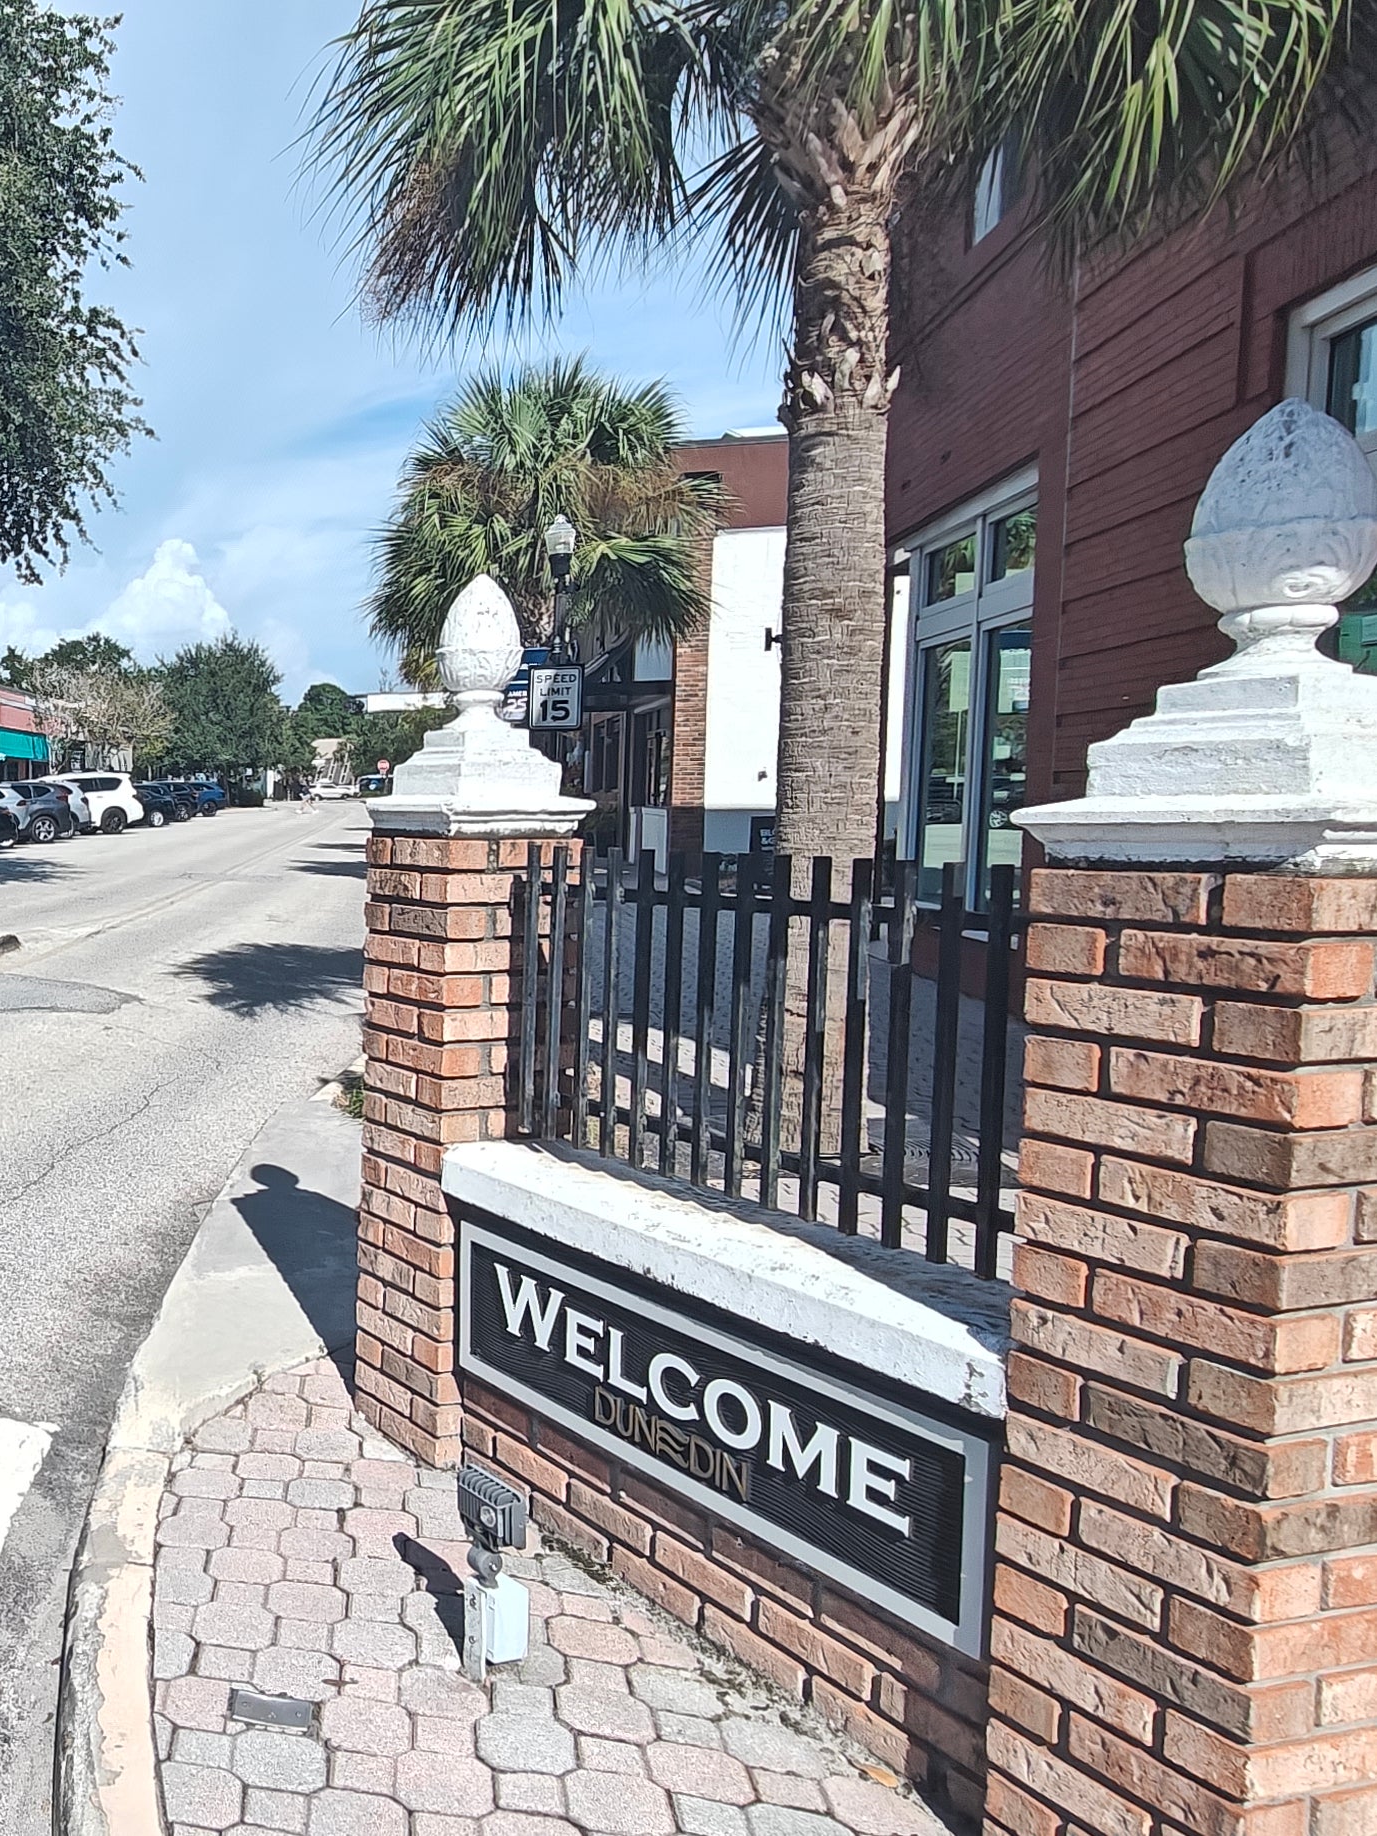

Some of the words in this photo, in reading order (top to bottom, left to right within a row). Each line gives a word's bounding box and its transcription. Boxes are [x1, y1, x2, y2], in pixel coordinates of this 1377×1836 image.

[535, 673, 577, 684] SPEED
[539, 686, 572, 697] LIMIT
[539, 699, 571, 722] 15
[493, 1262, 912, 1539] WELCOME
[593, 1385, 750, 1502] DUNEDIN
